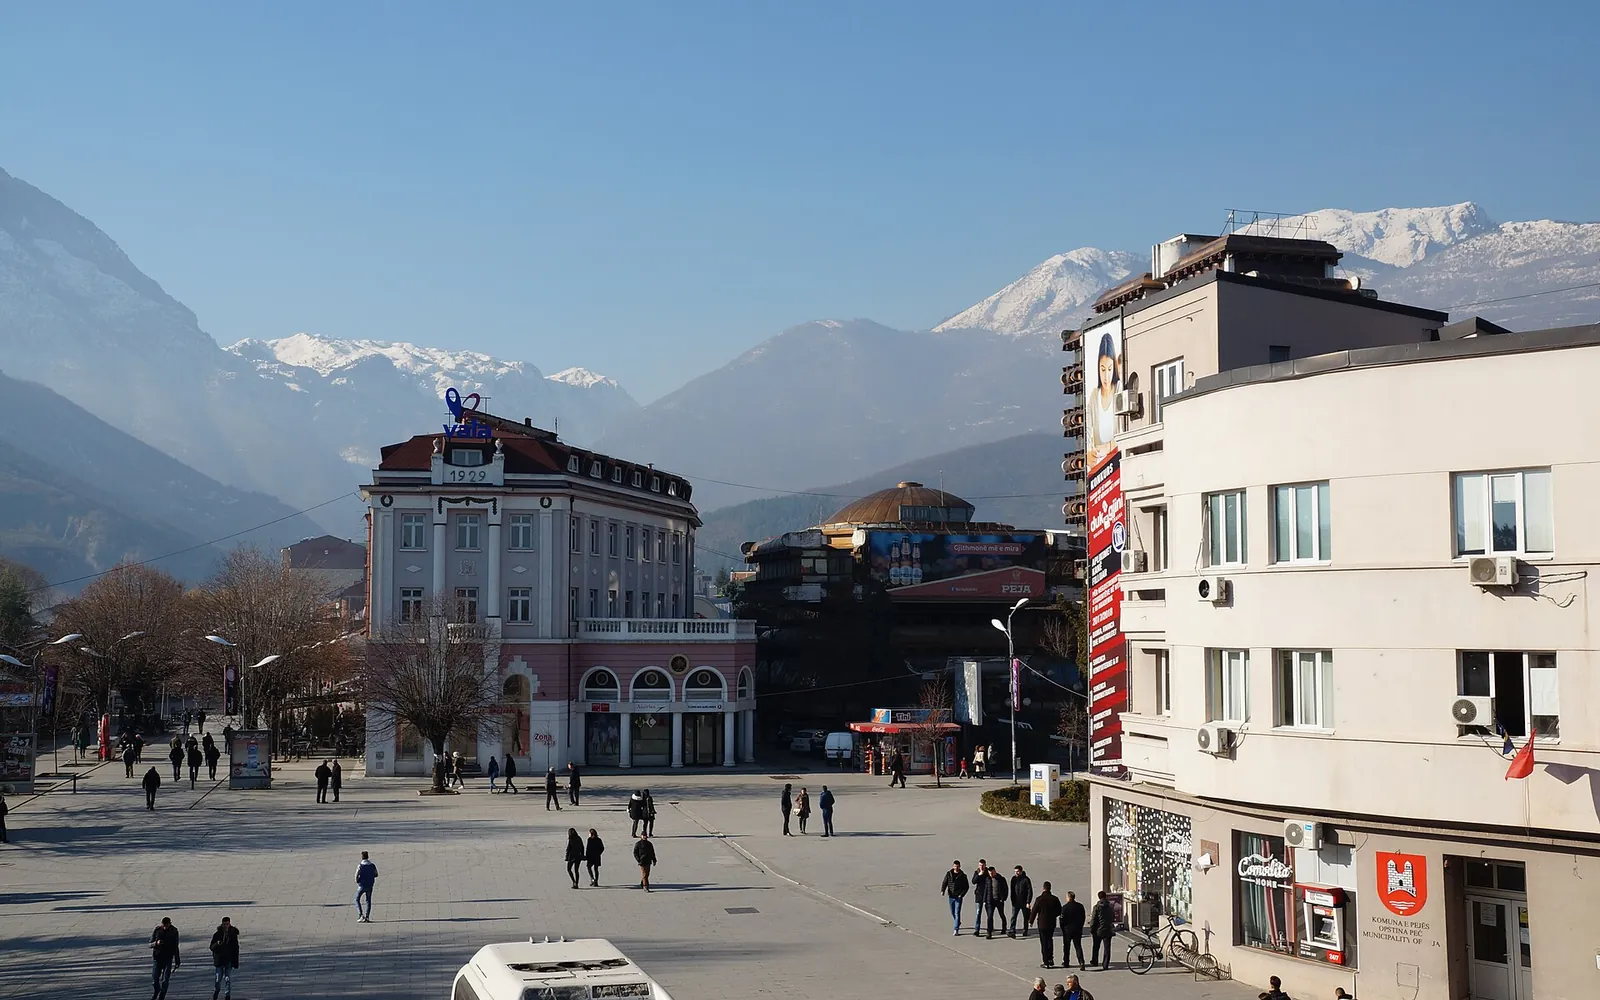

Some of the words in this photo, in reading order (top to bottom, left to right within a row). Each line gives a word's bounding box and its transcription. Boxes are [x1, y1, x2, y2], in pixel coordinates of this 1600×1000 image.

[443, 416, 492, 438] vala
[450, 470, 486, 482] 1929
[1002, 585, 1031, 594] PEJA
[1255, 877, 1278, 889] HOME
[1371, 916, 1403, 927] KOMUNA
[1362, 930, 1410, 943] MUNICIPALITY
